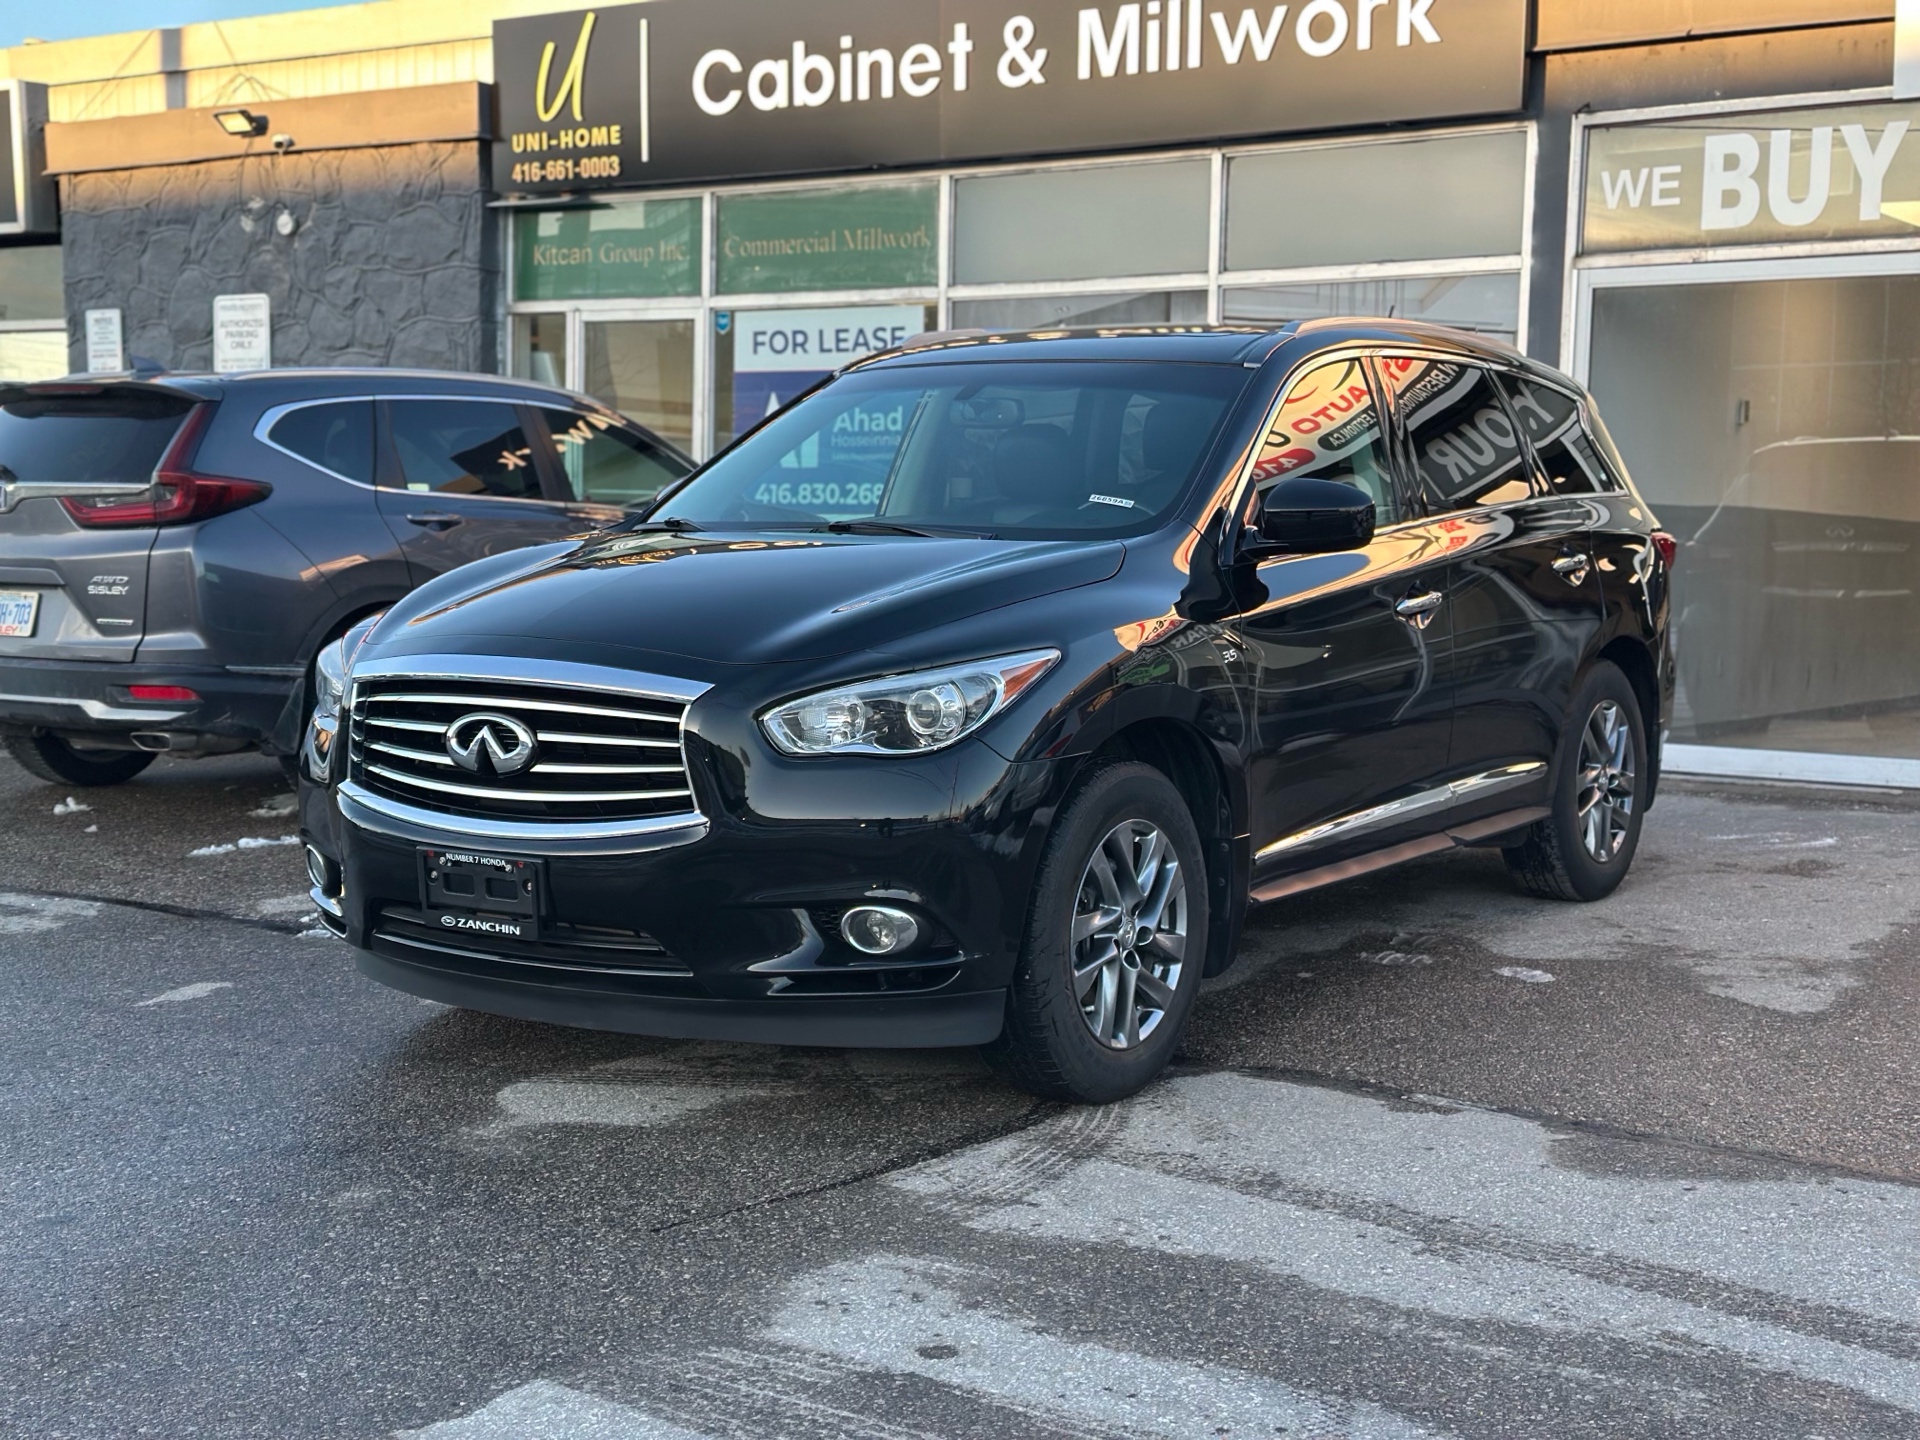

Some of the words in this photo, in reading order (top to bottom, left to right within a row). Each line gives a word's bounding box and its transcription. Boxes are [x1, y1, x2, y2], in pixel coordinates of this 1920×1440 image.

[691, 22, 974, 117] Cabinet
[997, 15, 1048, 88] &
[1077, 0, 1443, 80] Millwork
[511, 125, 621, 153] UNI-HOME
[511, 155, 620, 183] 416-661-0003
[1600, 165, 1682, 210] WE
[1700, 120, 1911, 231] BUY
[533, 244, 592, 266] Kitcan
[600, 242, 654, 268] Group
[723, 230, 836, 258] Commercial
[843, 225, 931, 250] Millwork
[752, 329, 809, 355] FOR
[818, 326, 906, 353] LEASE
[832, 406, 903, 433] Ahad
[87, 585, 129, 595] SISLEY
[89, 575, 129, 584] AWD
[445, 852, 475, 864] NUMBER
[474, 856, 479, 864] 7
[480, 857, 507, 868] HONDA
[457, 918, 520, 935] ZANCHIN
